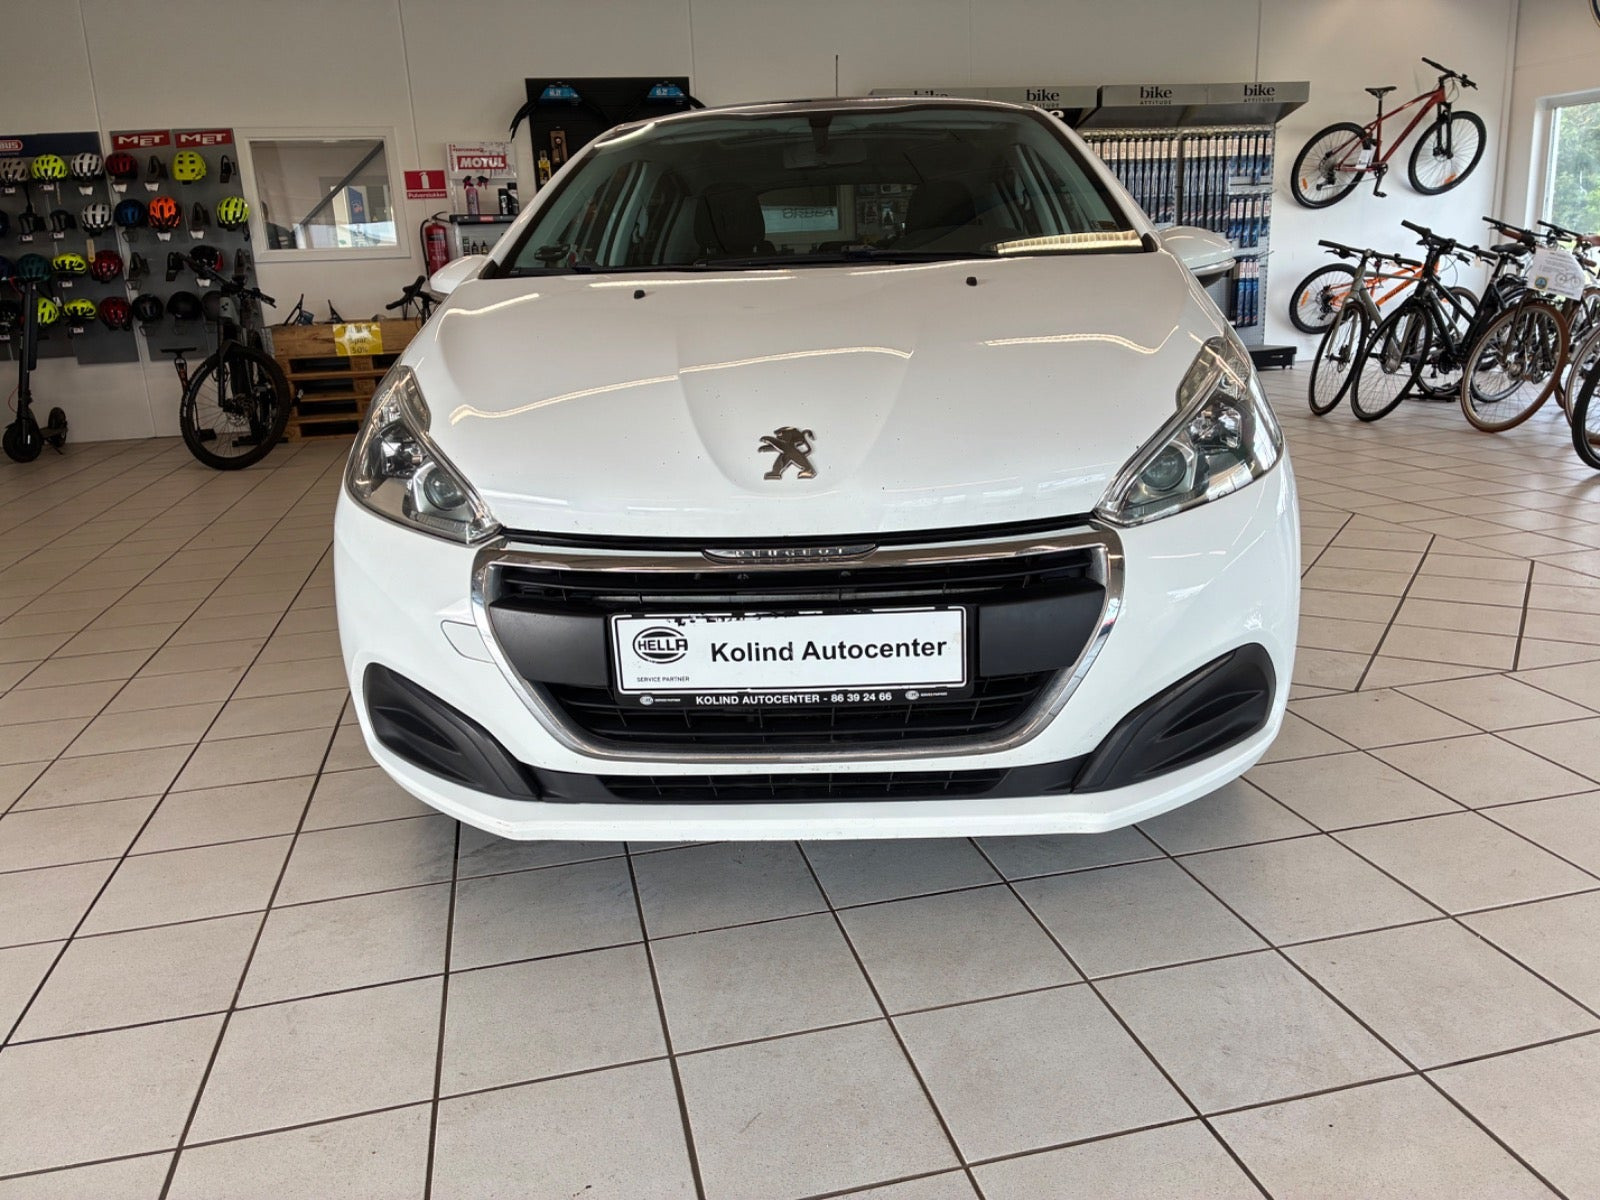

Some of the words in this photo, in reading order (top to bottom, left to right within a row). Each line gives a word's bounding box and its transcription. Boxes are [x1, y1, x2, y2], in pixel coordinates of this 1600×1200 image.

[1026, 88, 1060, 102] bike
[1140, 86, 1173, 99] bike
[1244, 84, 1276, 97] bike
[118, 135, 164, 146] MET
[180, 133, 226, 145] MET
[459, 157, 506, 169] MOTUL
[638, 638, 689, 652] HELLA
[711, 642, 794, 662] Kolind
[801, 638, 947, 661] Autocenter
[695, 695, 740, 706] KOLIND
[742, 694, 821, 705] AUTOCENTER
[831, 693, 845, 703] 86
[847, 693, 861, 702] 39
[863, 693, 877, 702] 24
[879, 692, 893, 701] 66
